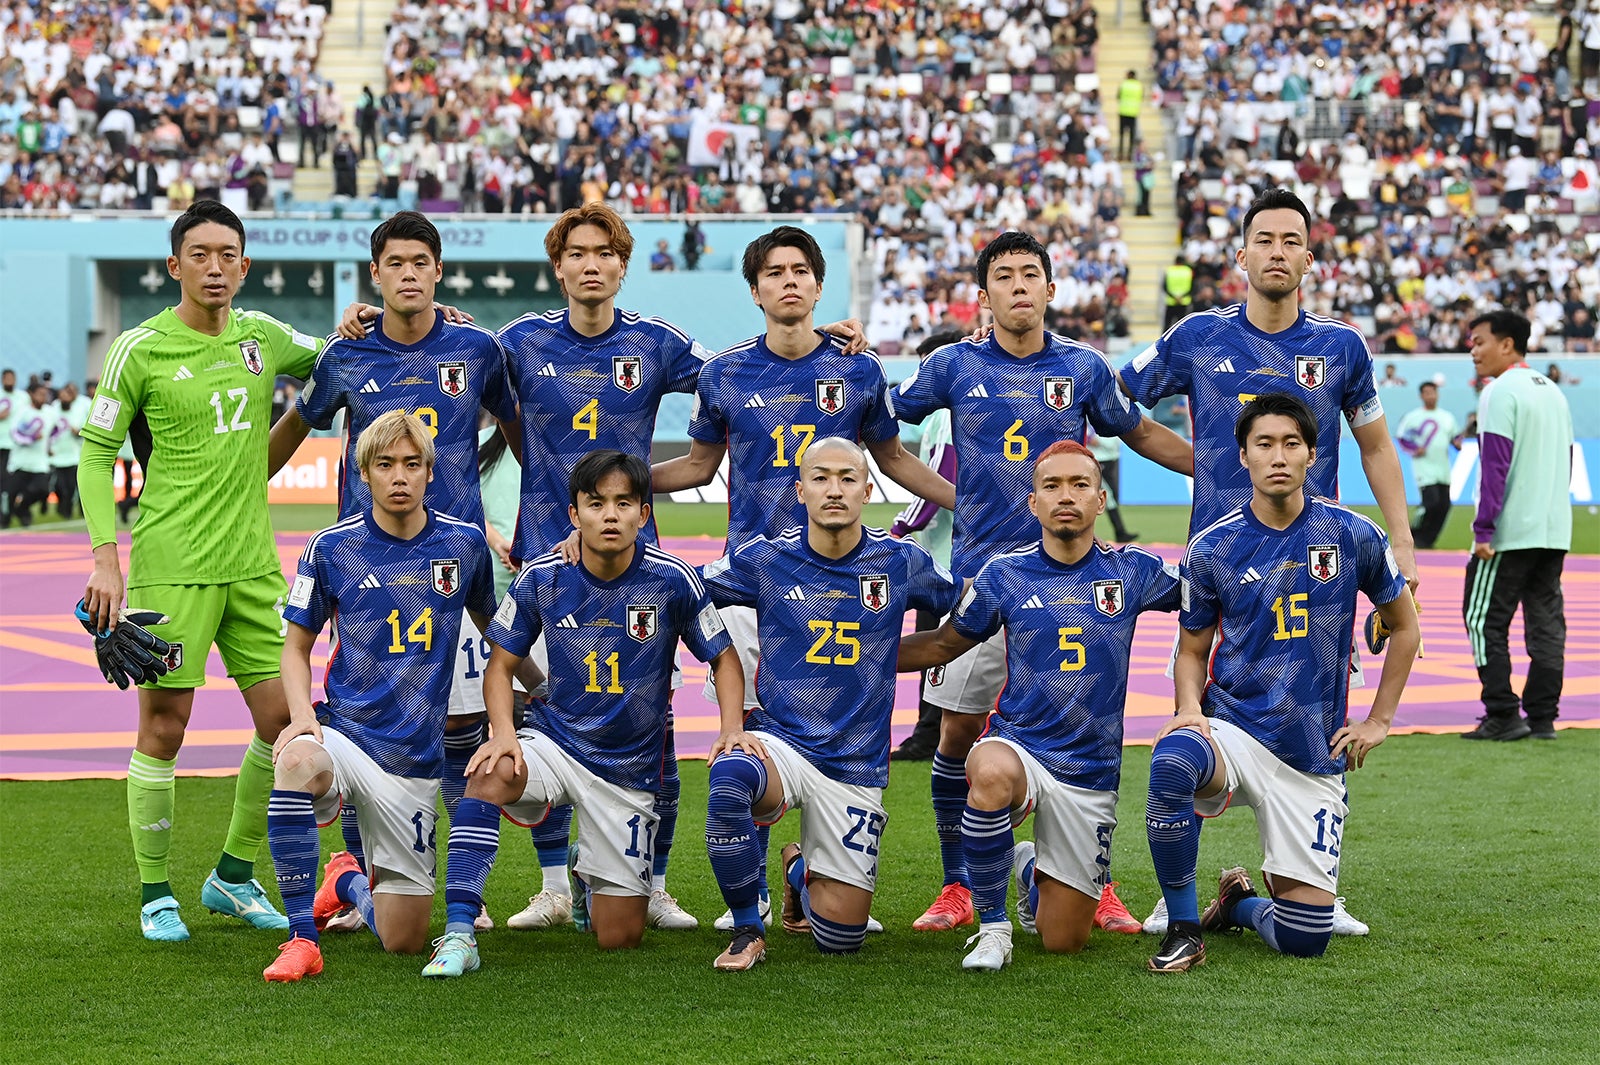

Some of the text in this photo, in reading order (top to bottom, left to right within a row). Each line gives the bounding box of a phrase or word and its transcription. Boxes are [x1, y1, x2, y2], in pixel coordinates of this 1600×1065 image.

[246, 228, 288, 245] RLD
[293, 228, 331, 246] CUP
[441, 228, 484, 246] 022
[209, 387, 252, 434] 12
[573, 398, 599, 440] 4
[770, 424, 816, 467] 17
[1004, 419, 1029, 461] 6
[268, 456, 327, 488] nal
[386, 607, 433, 653] 14
[1271, 593, 1309, 640] 15
[805, 620, 861, 665] 25
[1058, 627, 1087, 671] 5
[583, 651, 624, 694] 11
[625, 815, 656, 862] 11
[705, 834, 751, 844] JAPAN
[842, 805, 884, 856] 25
[937, 824, 961, 832] APA
[1147, 818, 1190, 829] JAPAN
[1311, 808, 1343, 858] 15
[276, 872, 310, 882] APAN
